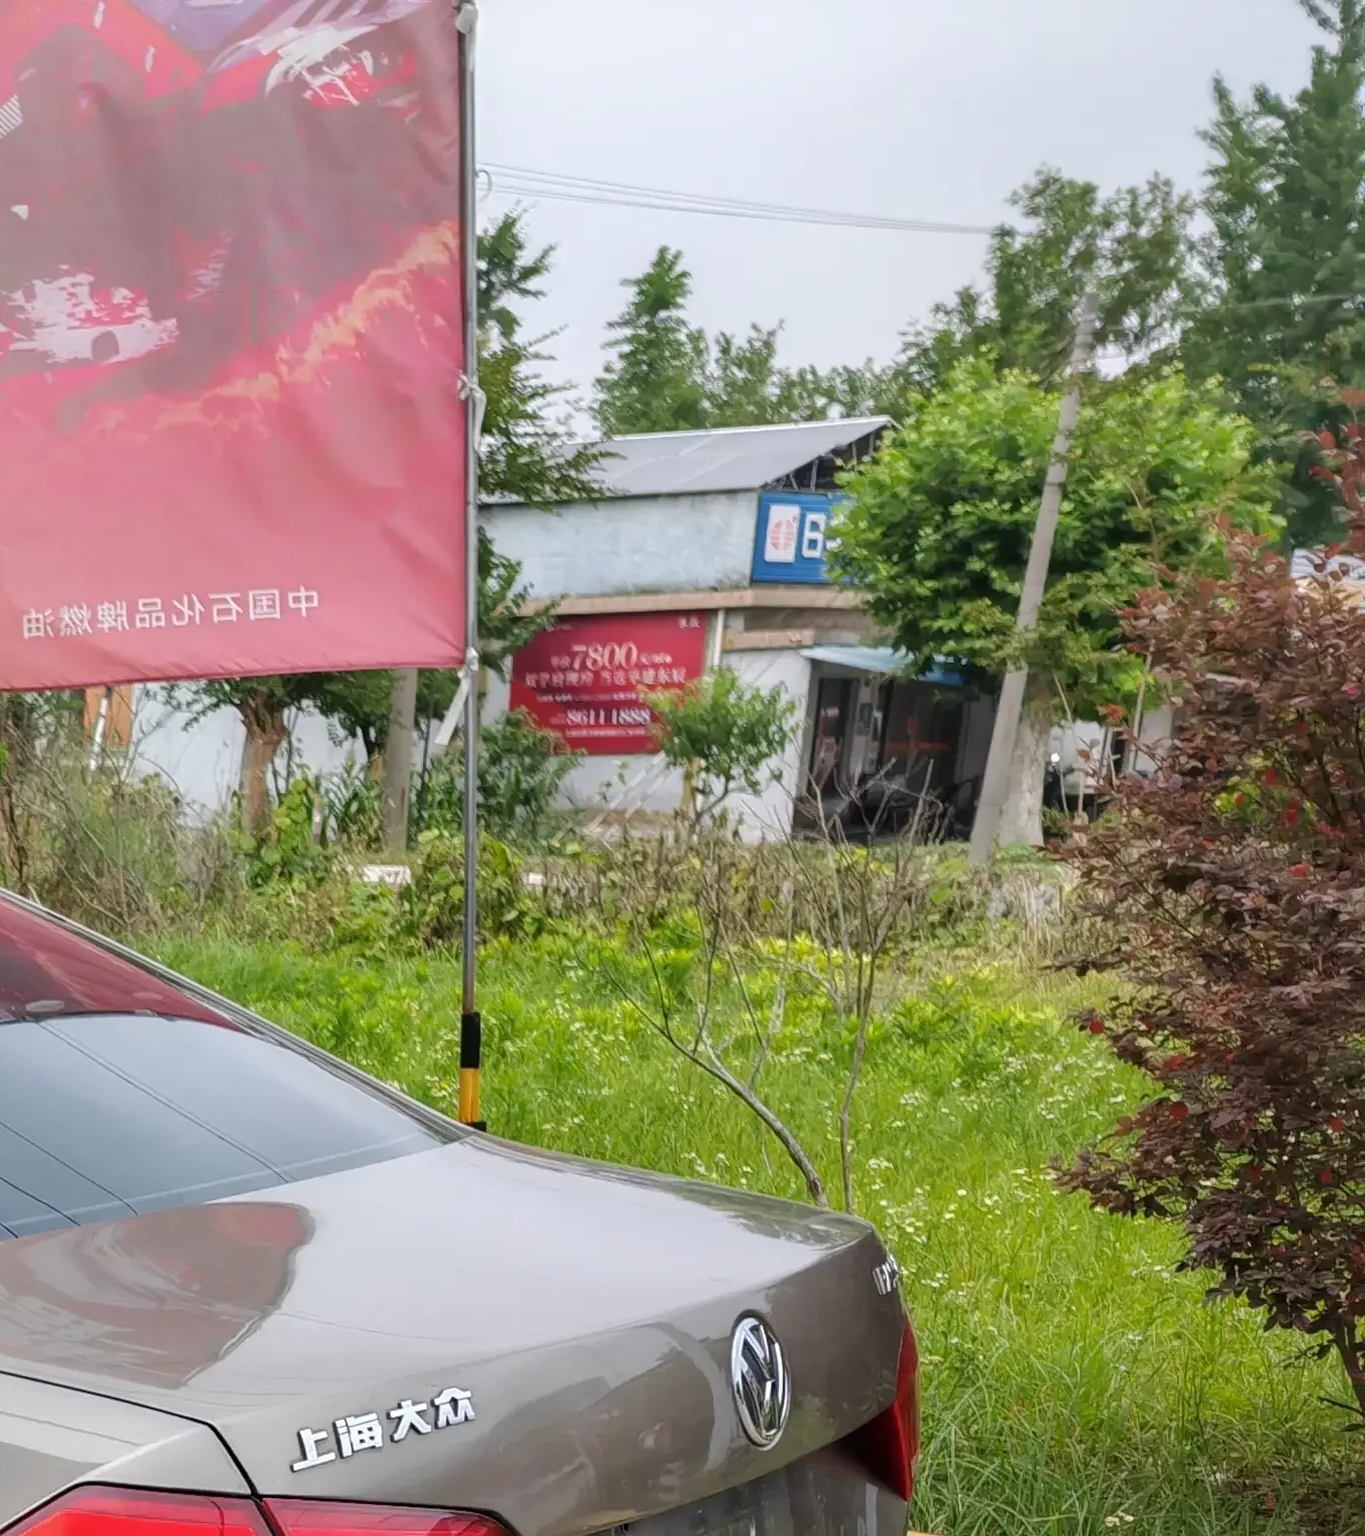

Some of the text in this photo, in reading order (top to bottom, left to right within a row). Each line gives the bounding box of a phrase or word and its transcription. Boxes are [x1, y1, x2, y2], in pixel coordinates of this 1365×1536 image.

[571, 641, 638, 671] 7800
[289, 1386, 477, 1472] 上海大众
